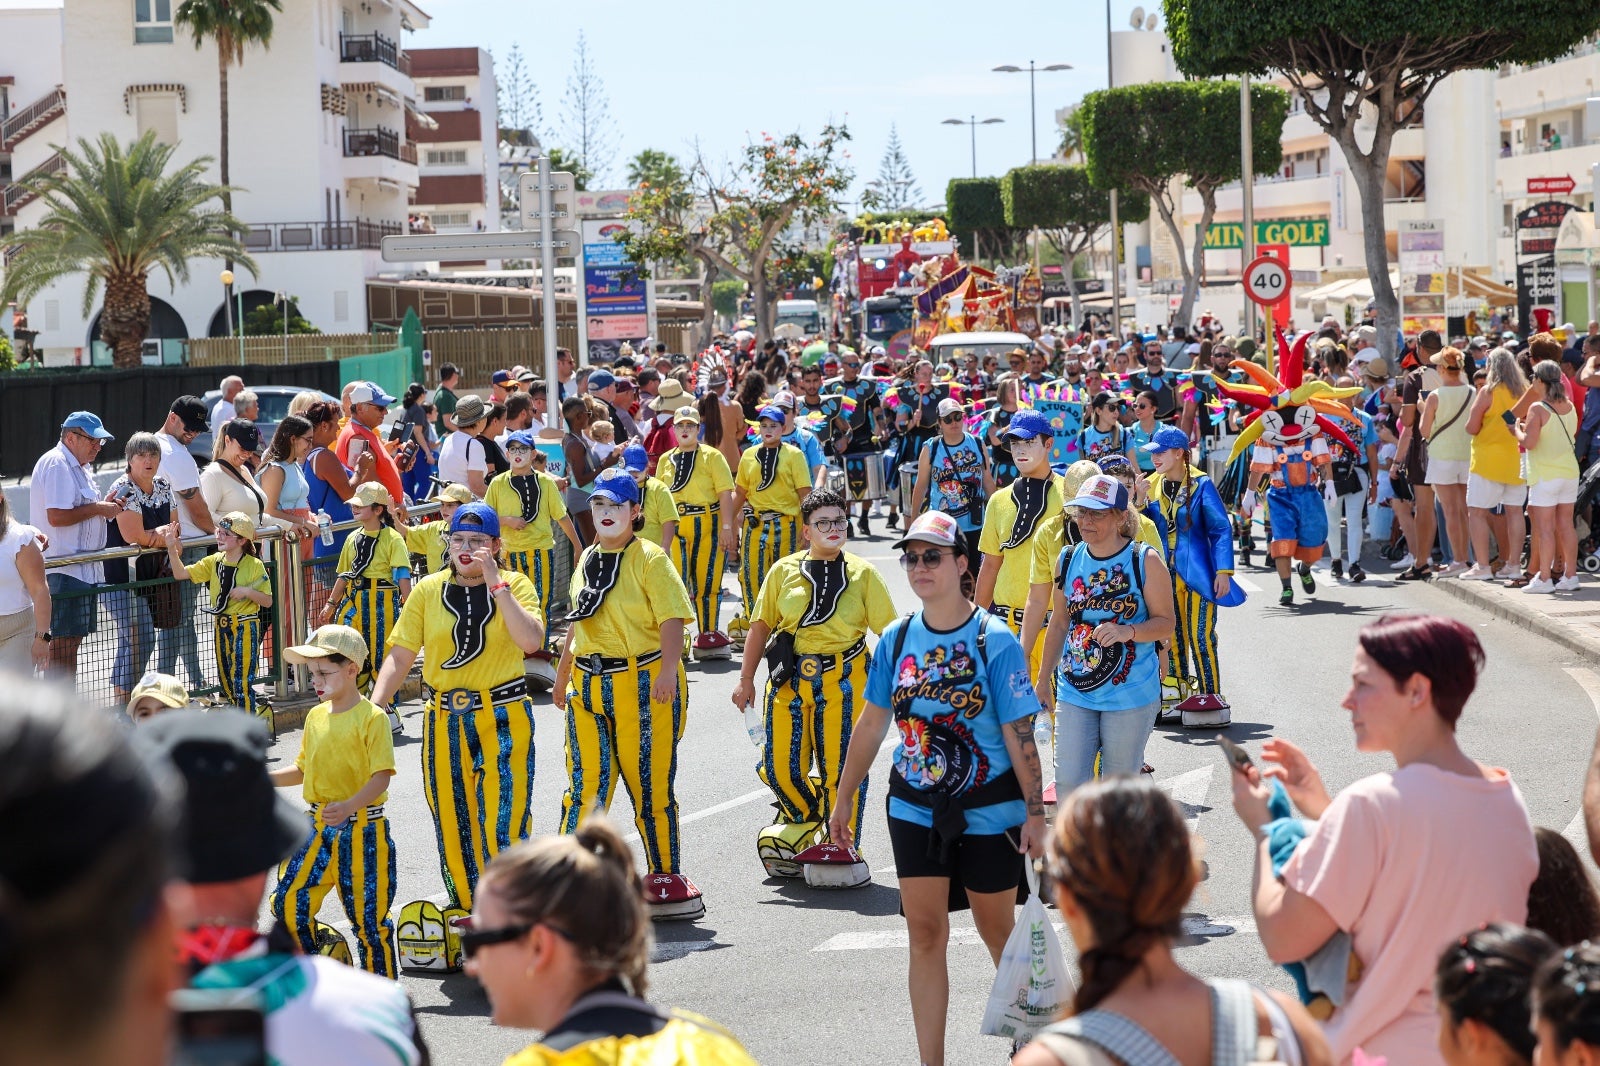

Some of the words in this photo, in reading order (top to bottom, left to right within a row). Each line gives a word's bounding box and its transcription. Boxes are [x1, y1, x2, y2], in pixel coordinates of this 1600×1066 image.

[1202, 224, 1260, 248] MINI
[1265, 222, 1326, 245] GOLF
[1253, 273, 1282, 289] 40
[801, 658, 817, 677] G
[452, 691, 471, 710] G
